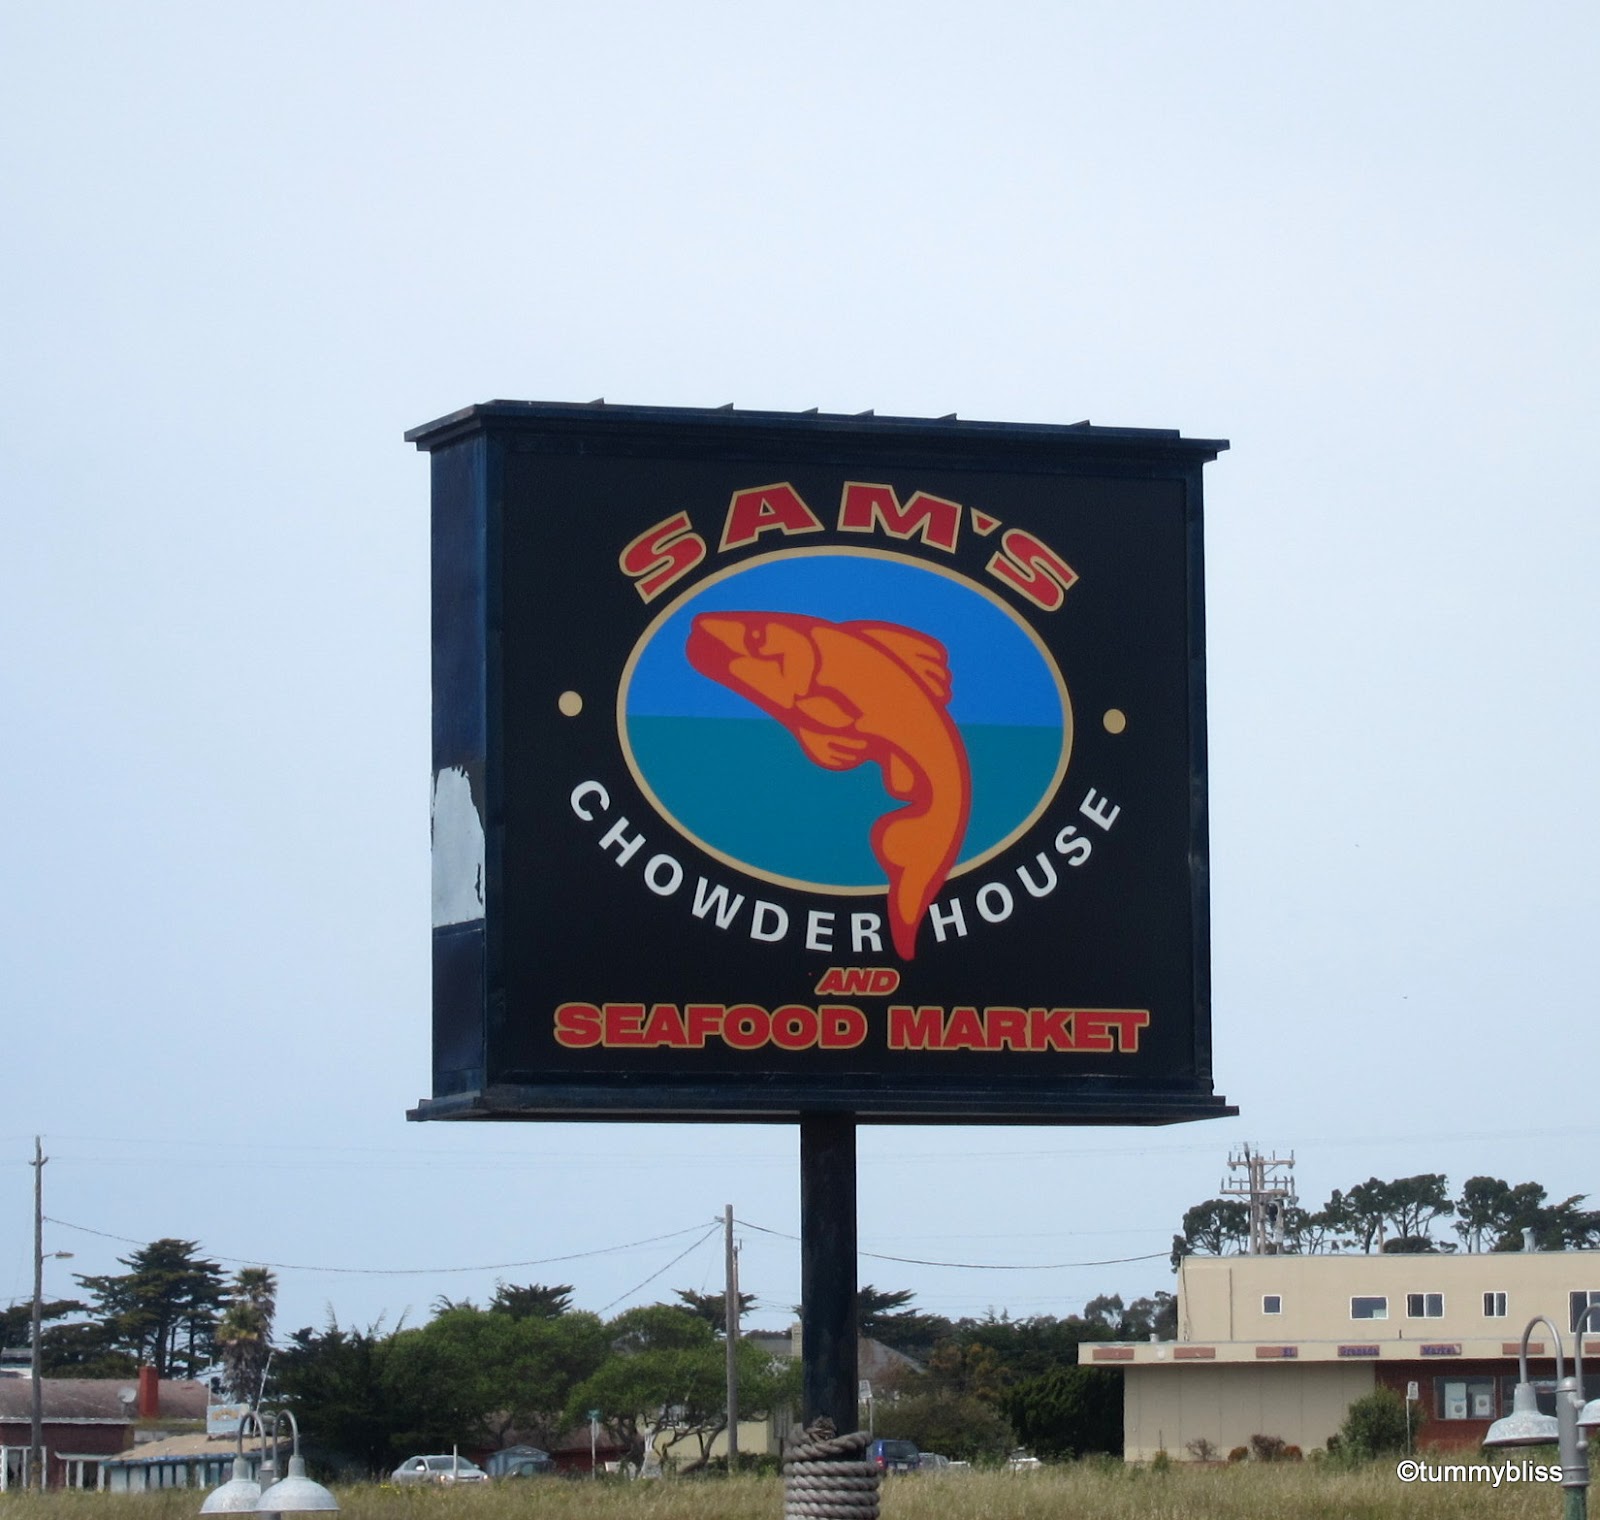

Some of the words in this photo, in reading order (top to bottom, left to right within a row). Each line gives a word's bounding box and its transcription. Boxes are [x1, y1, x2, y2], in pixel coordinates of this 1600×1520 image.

[619, 482, 1079, 611] SAM'S
[571, 781, 882, 952] CHOWDER
[929, 787, 1120, 942] HOUSE
[815, 967, 901, 997] AND
[553, 1002, 869, 1051] SEAFOOD
[886, 1006, 1151, 1055] MARKET
